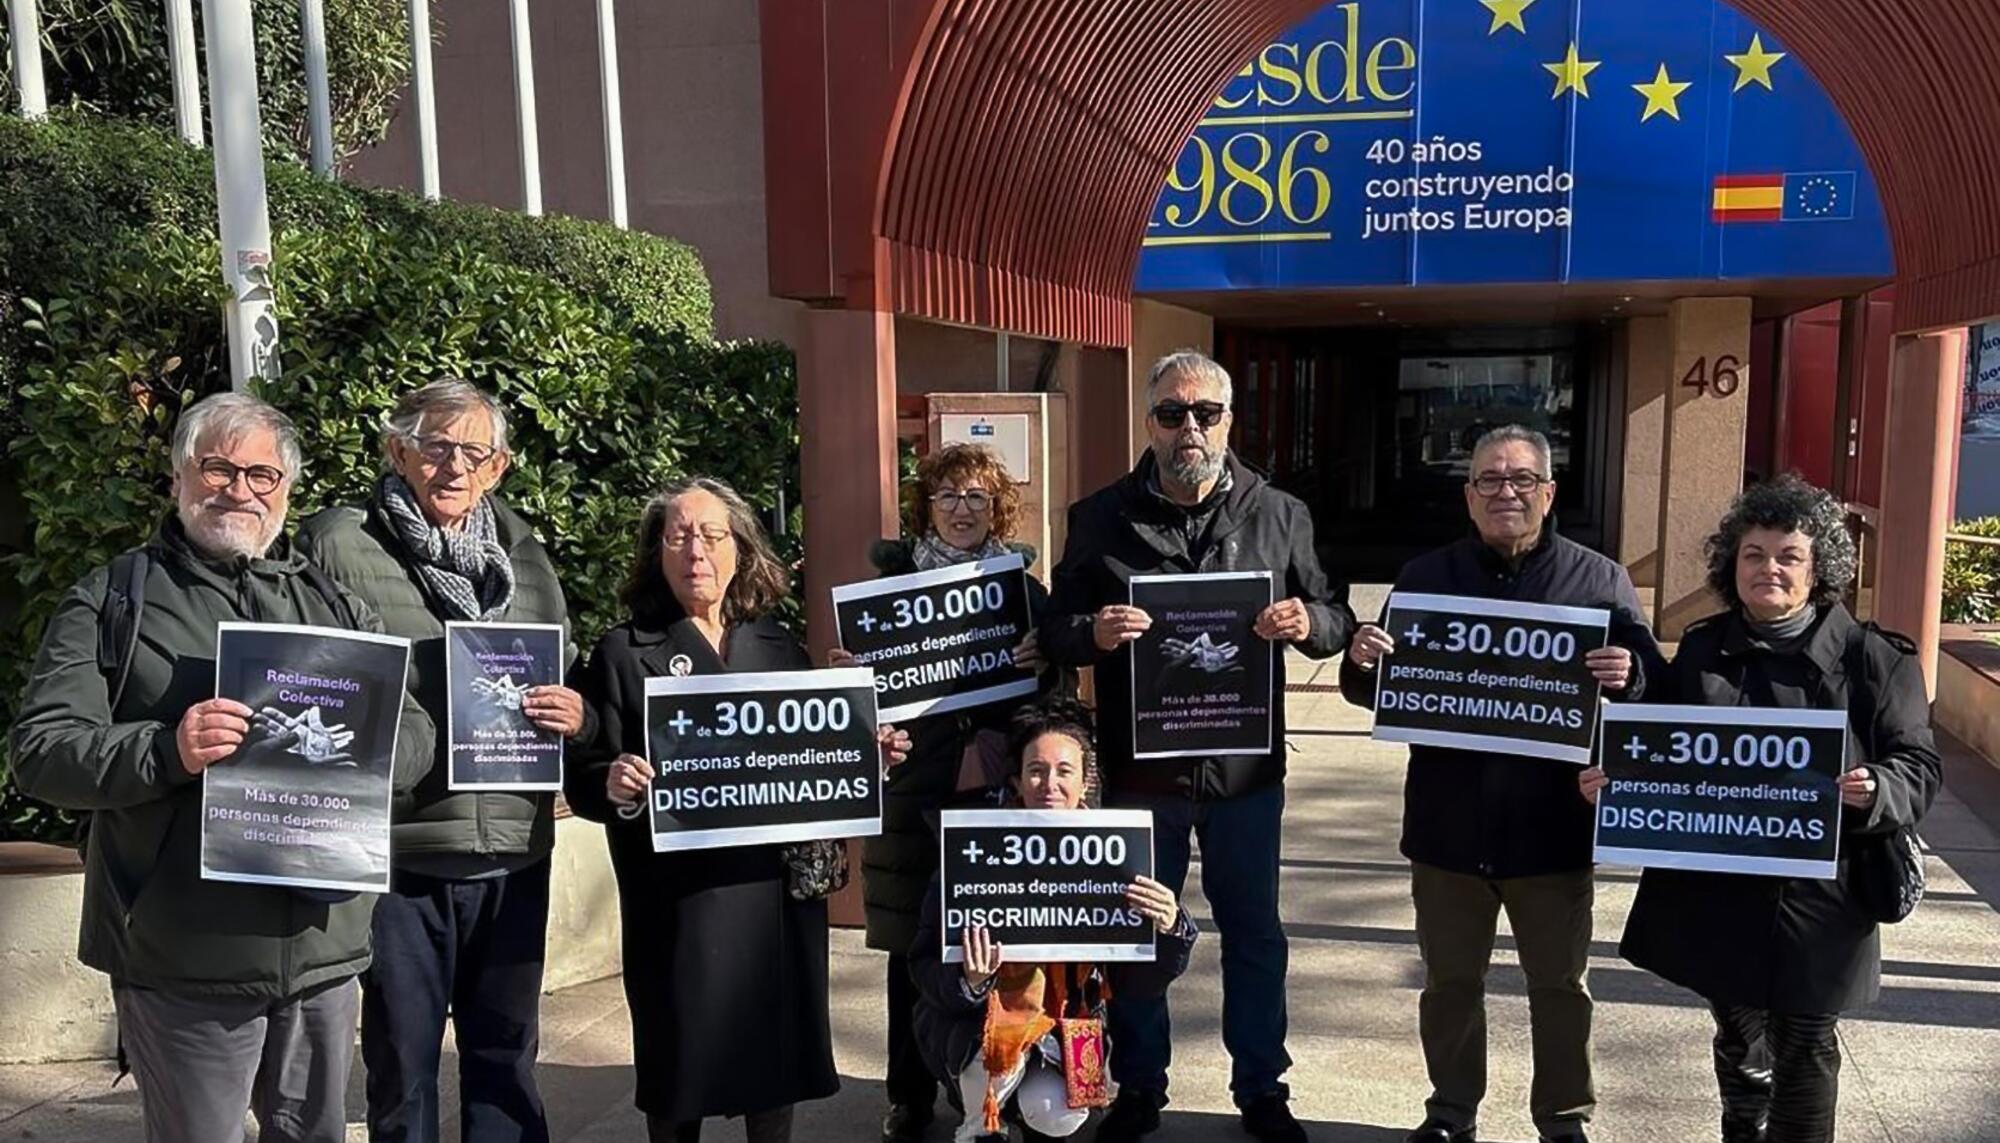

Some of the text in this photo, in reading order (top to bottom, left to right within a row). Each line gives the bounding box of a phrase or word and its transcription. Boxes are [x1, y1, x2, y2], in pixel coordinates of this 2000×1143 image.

[1365, 135, 1482, 164] 40 años
[1148, 131, 1331, 228] 986
[1365, 165, 1574, 201] construyendo
[1362, 203, 1572, 239] juntos Europa
[1681, 355, 1740, 398] 46
[879, 620, 893, 632] de
[892, 581, 1004, 628] 30.000
[922, 622, 1017, 654] dependientes
[1427, 639, 1441, 651] de
[1445, 621, 1575, 662] 30.000
[267, 669, 360, 692] Reclamación
[875, 648, 1013, 693] SCRIMINADA
[1390, 665, 1580, 695] personas dependientes
[279, 690, 344, 708] Colectiva
[1380, 690, 1583, 728] DISCRIMINADAS
[696, 725, 712, 737] de
[715, 697, 850, 736] 30.000
[1137, 709, 1188, 721] personas
[1162, 719, 1241, 731] discriminadas
[661, 748, 862, 776] personas dependientes
[1650, 752, 1665, 763] de
[1668, 731, 1811, 769] 30.000
[279, 792, 297, 805] de
[301, 794, 350, 810] 30.000
[654, 777, 869, 812] DISCRIMINADAS
[1611, 780, 1819, 802] personas dependientes
[209, 806, 279, 824] personas
[1601, 806, 1824, 840] DISCRIMINADAS
[986, 855, 1000, 865] de
[1002, 835, 1126, 865] 30.000
[954, 879, 1127, 898] personas dependiente
[948, 907, 1143, 928] DISCRIMINADAS
